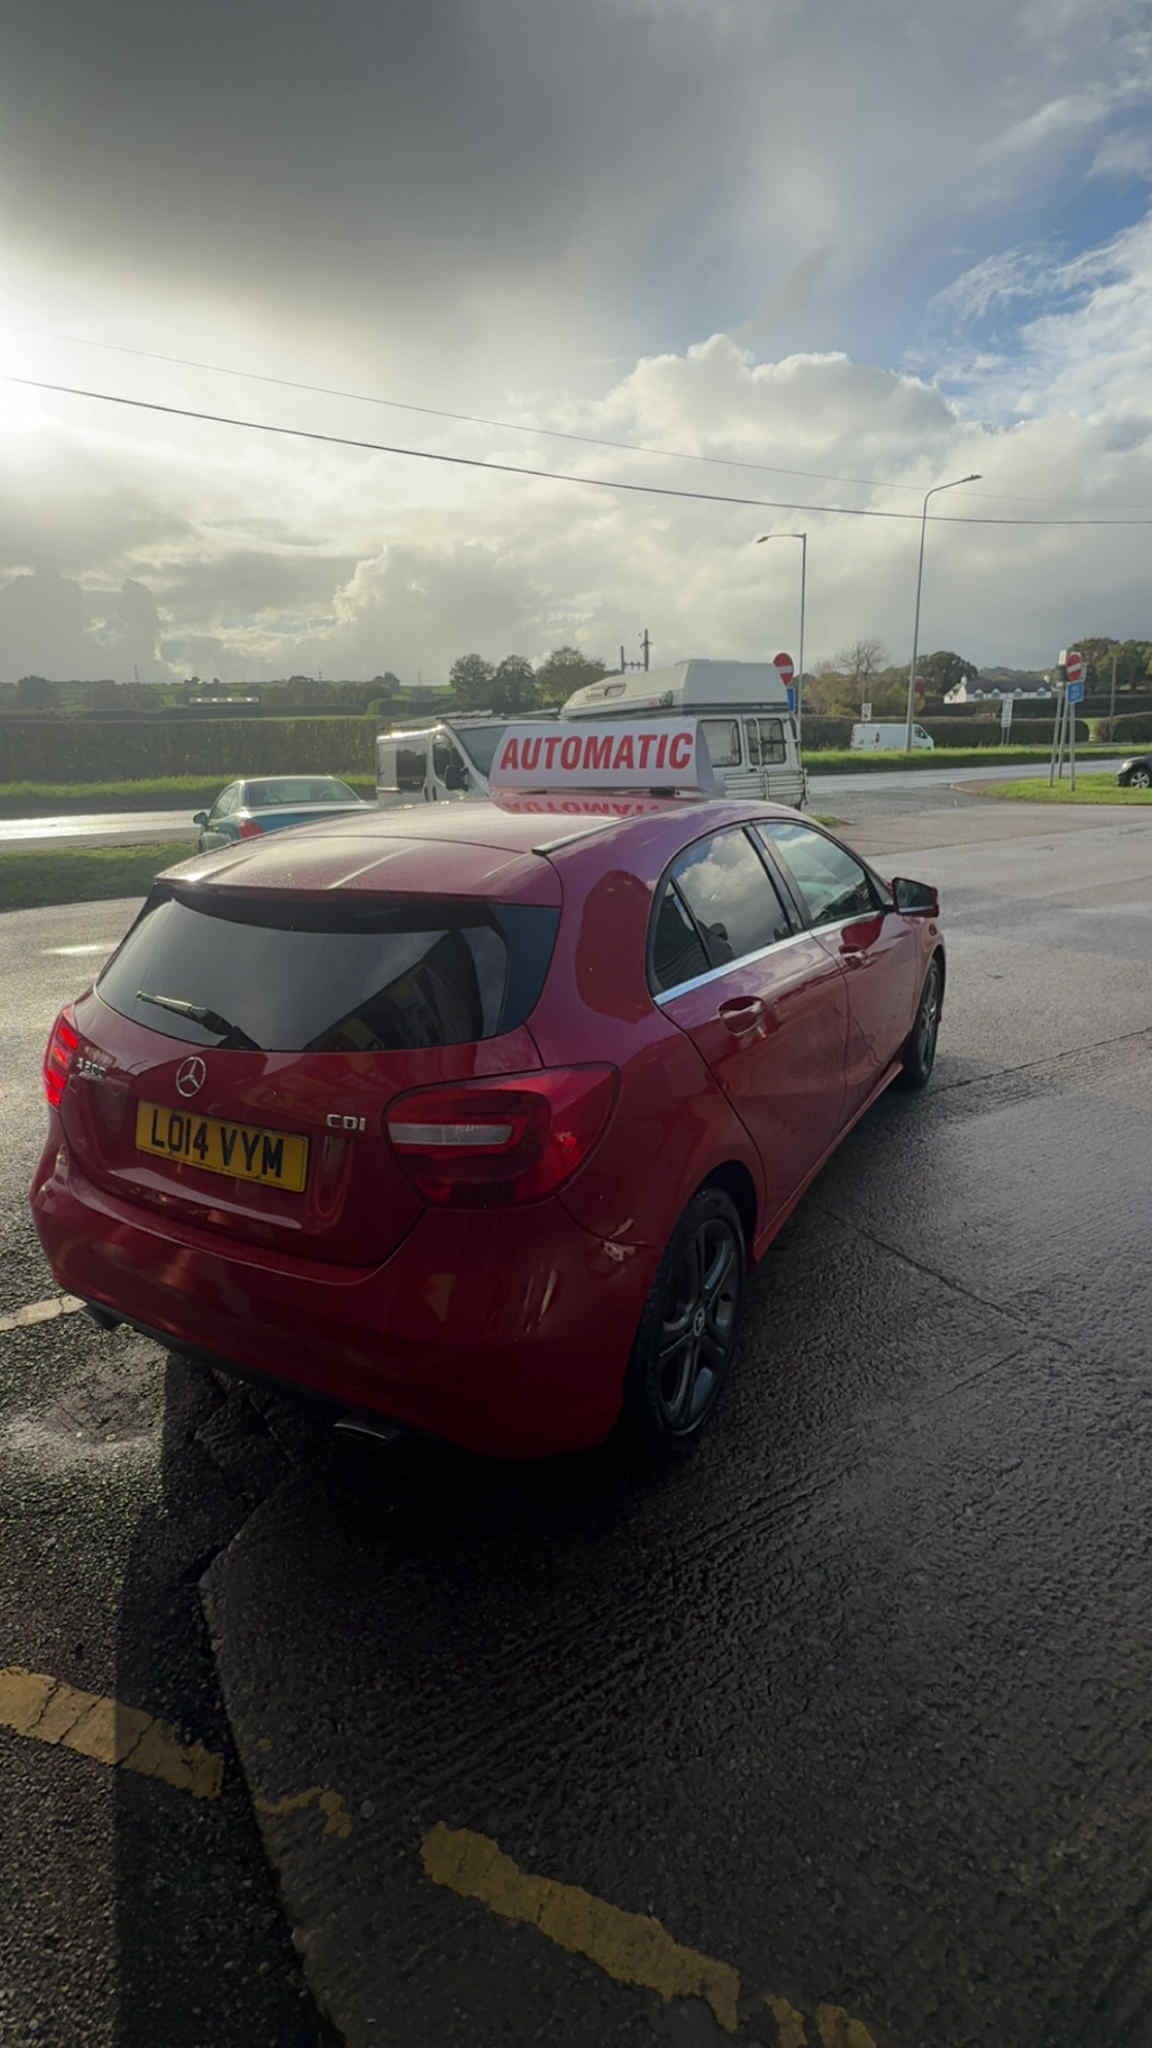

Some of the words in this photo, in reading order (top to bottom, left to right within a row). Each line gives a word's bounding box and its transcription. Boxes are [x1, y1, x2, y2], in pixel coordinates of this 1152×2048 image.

[500, 732, 694, 770] AUTOMATIC
[326, 1113, 366, 1130] CDI
[151, 1109, 208, 1160] LO14
[220, 1127, 284, 1177] VYM
